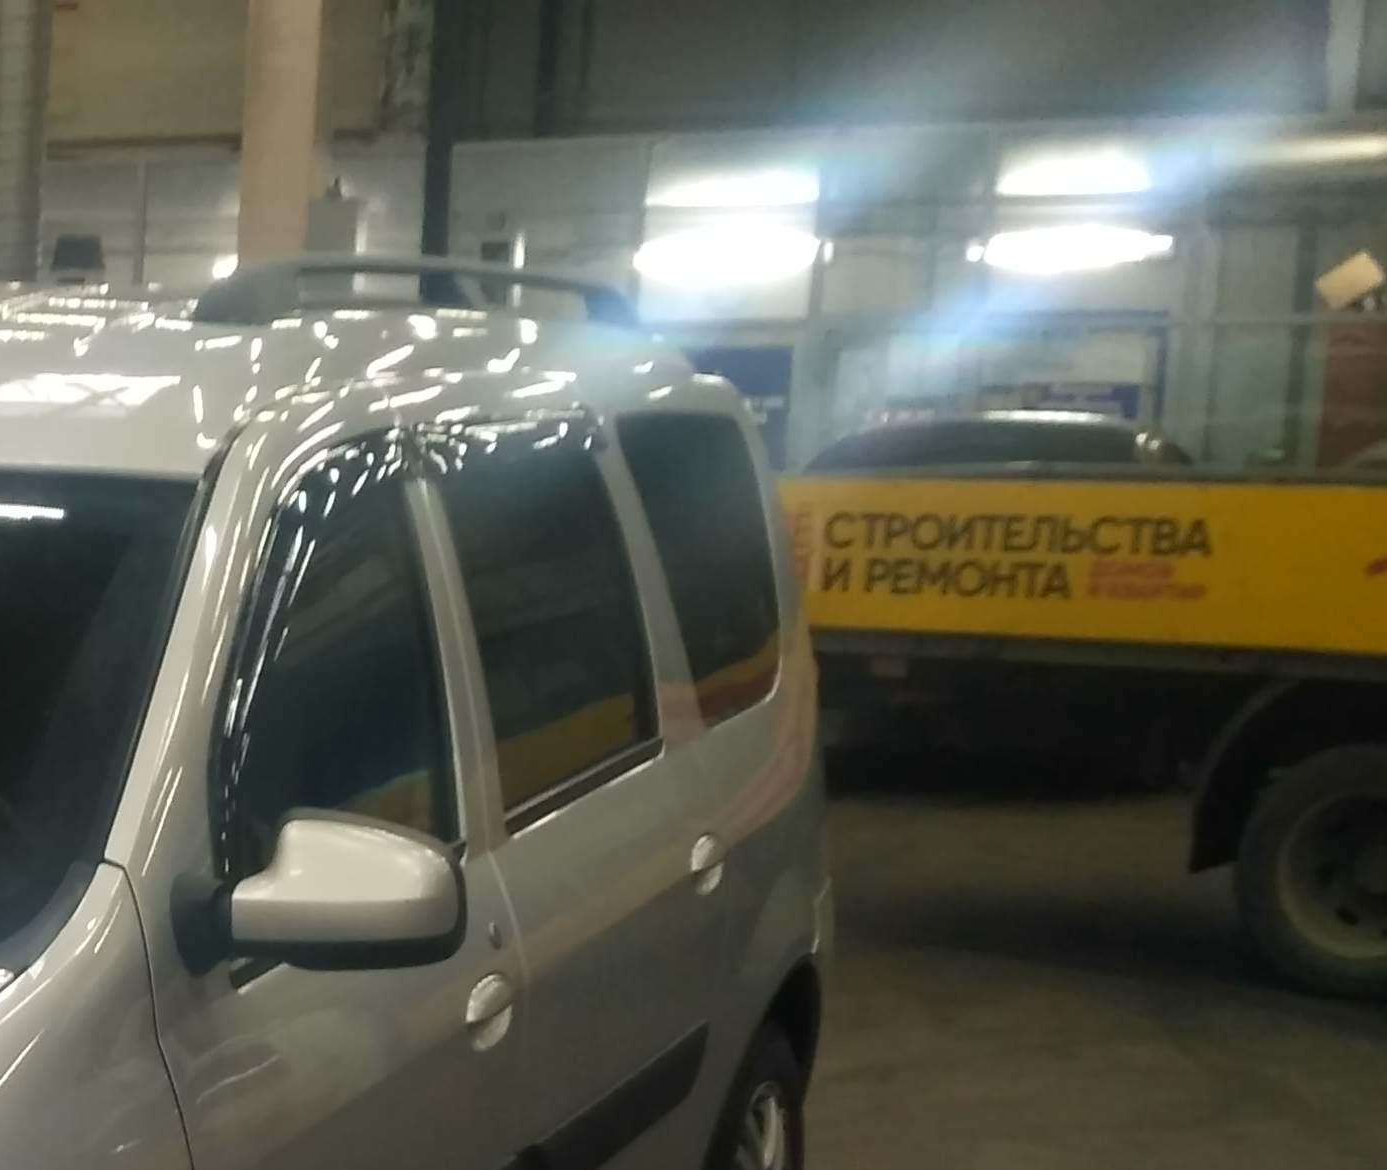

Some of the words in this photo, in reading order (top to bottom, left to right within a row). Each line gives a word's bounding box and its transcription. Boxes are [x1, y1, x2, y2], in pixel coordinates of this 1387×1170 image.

[825, 511, 1212, 557] СТРОИТЕЛЬСТВА
[820, 557, 851, 593] И
[864, 559, 1070, 599] РЕМОНТА
